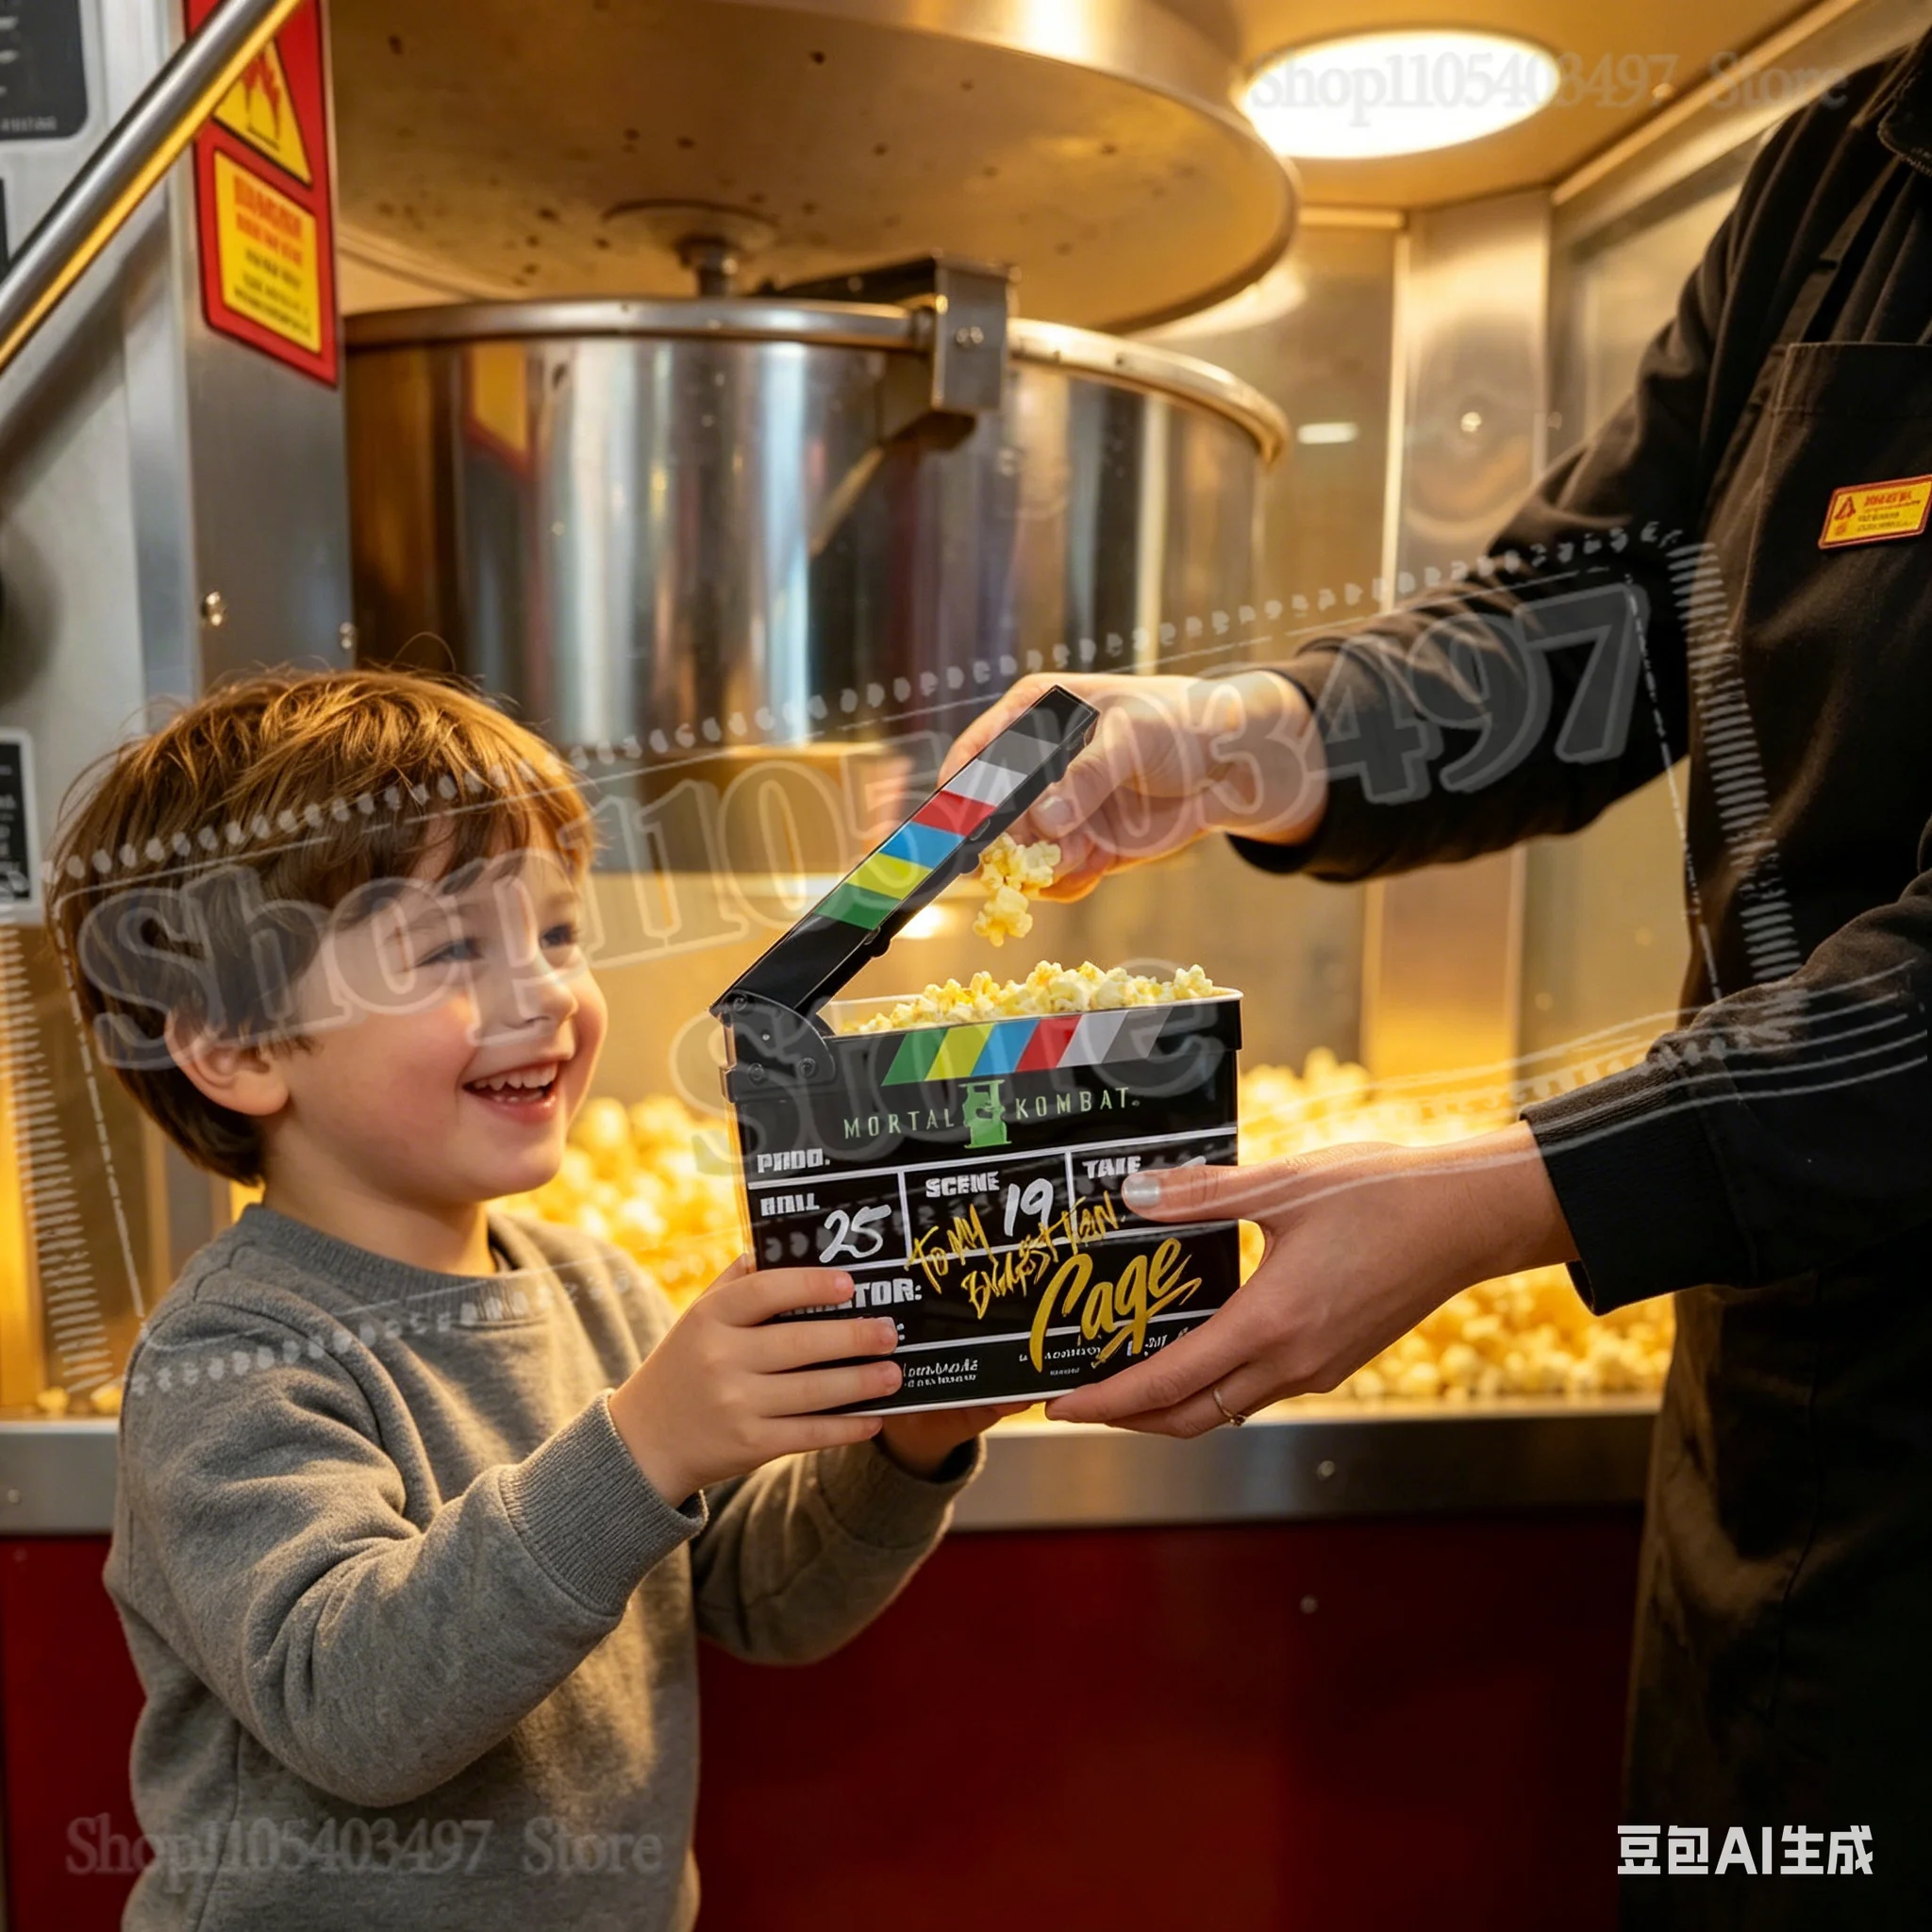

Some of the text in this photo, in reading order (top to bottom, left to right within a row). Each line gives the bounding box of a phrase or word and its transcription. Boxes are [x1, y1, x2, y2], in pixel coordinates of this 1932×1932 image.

[842, 1108, 955, 1139] MORTAL
[925, 1171, 1000, 1198] SCENE
[1004, 1178, 1054, 1237] 19
[819, 1204, 892, 1263] 25
[1030, 1238, 1202, 1372] Cage
